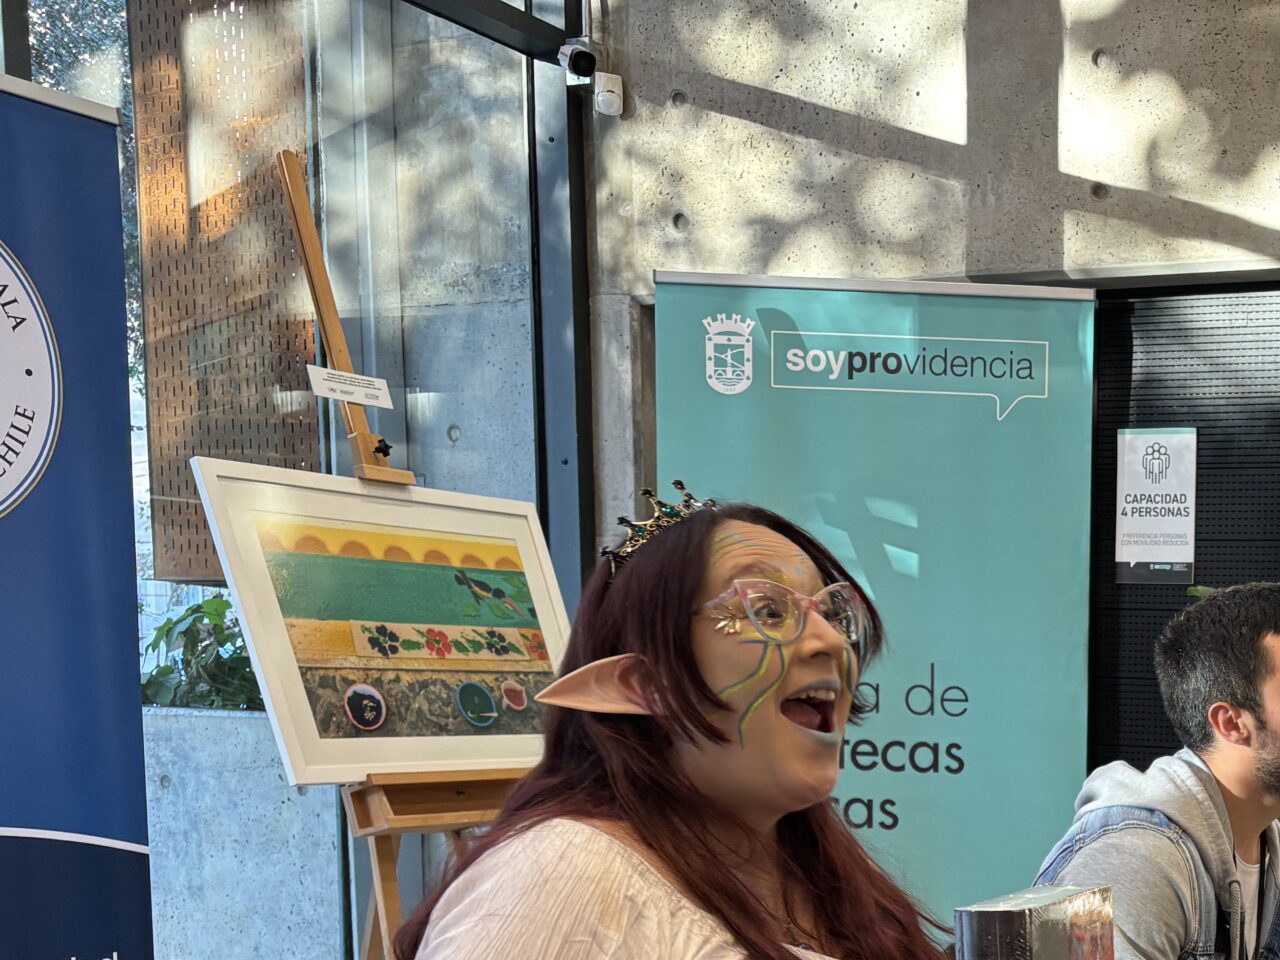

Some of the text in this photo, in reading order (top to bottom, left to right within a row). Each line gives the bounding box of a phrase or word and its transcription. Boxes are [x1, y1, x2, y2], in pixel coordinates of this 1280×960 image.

[786, 348, 1034, 380] soyprovidencia
[1124, 493, 1187, 504] CAPACIDAD
[1121, 507, 1190, 517] 4 PERSONAS
[905, 662, 968, 717] de
